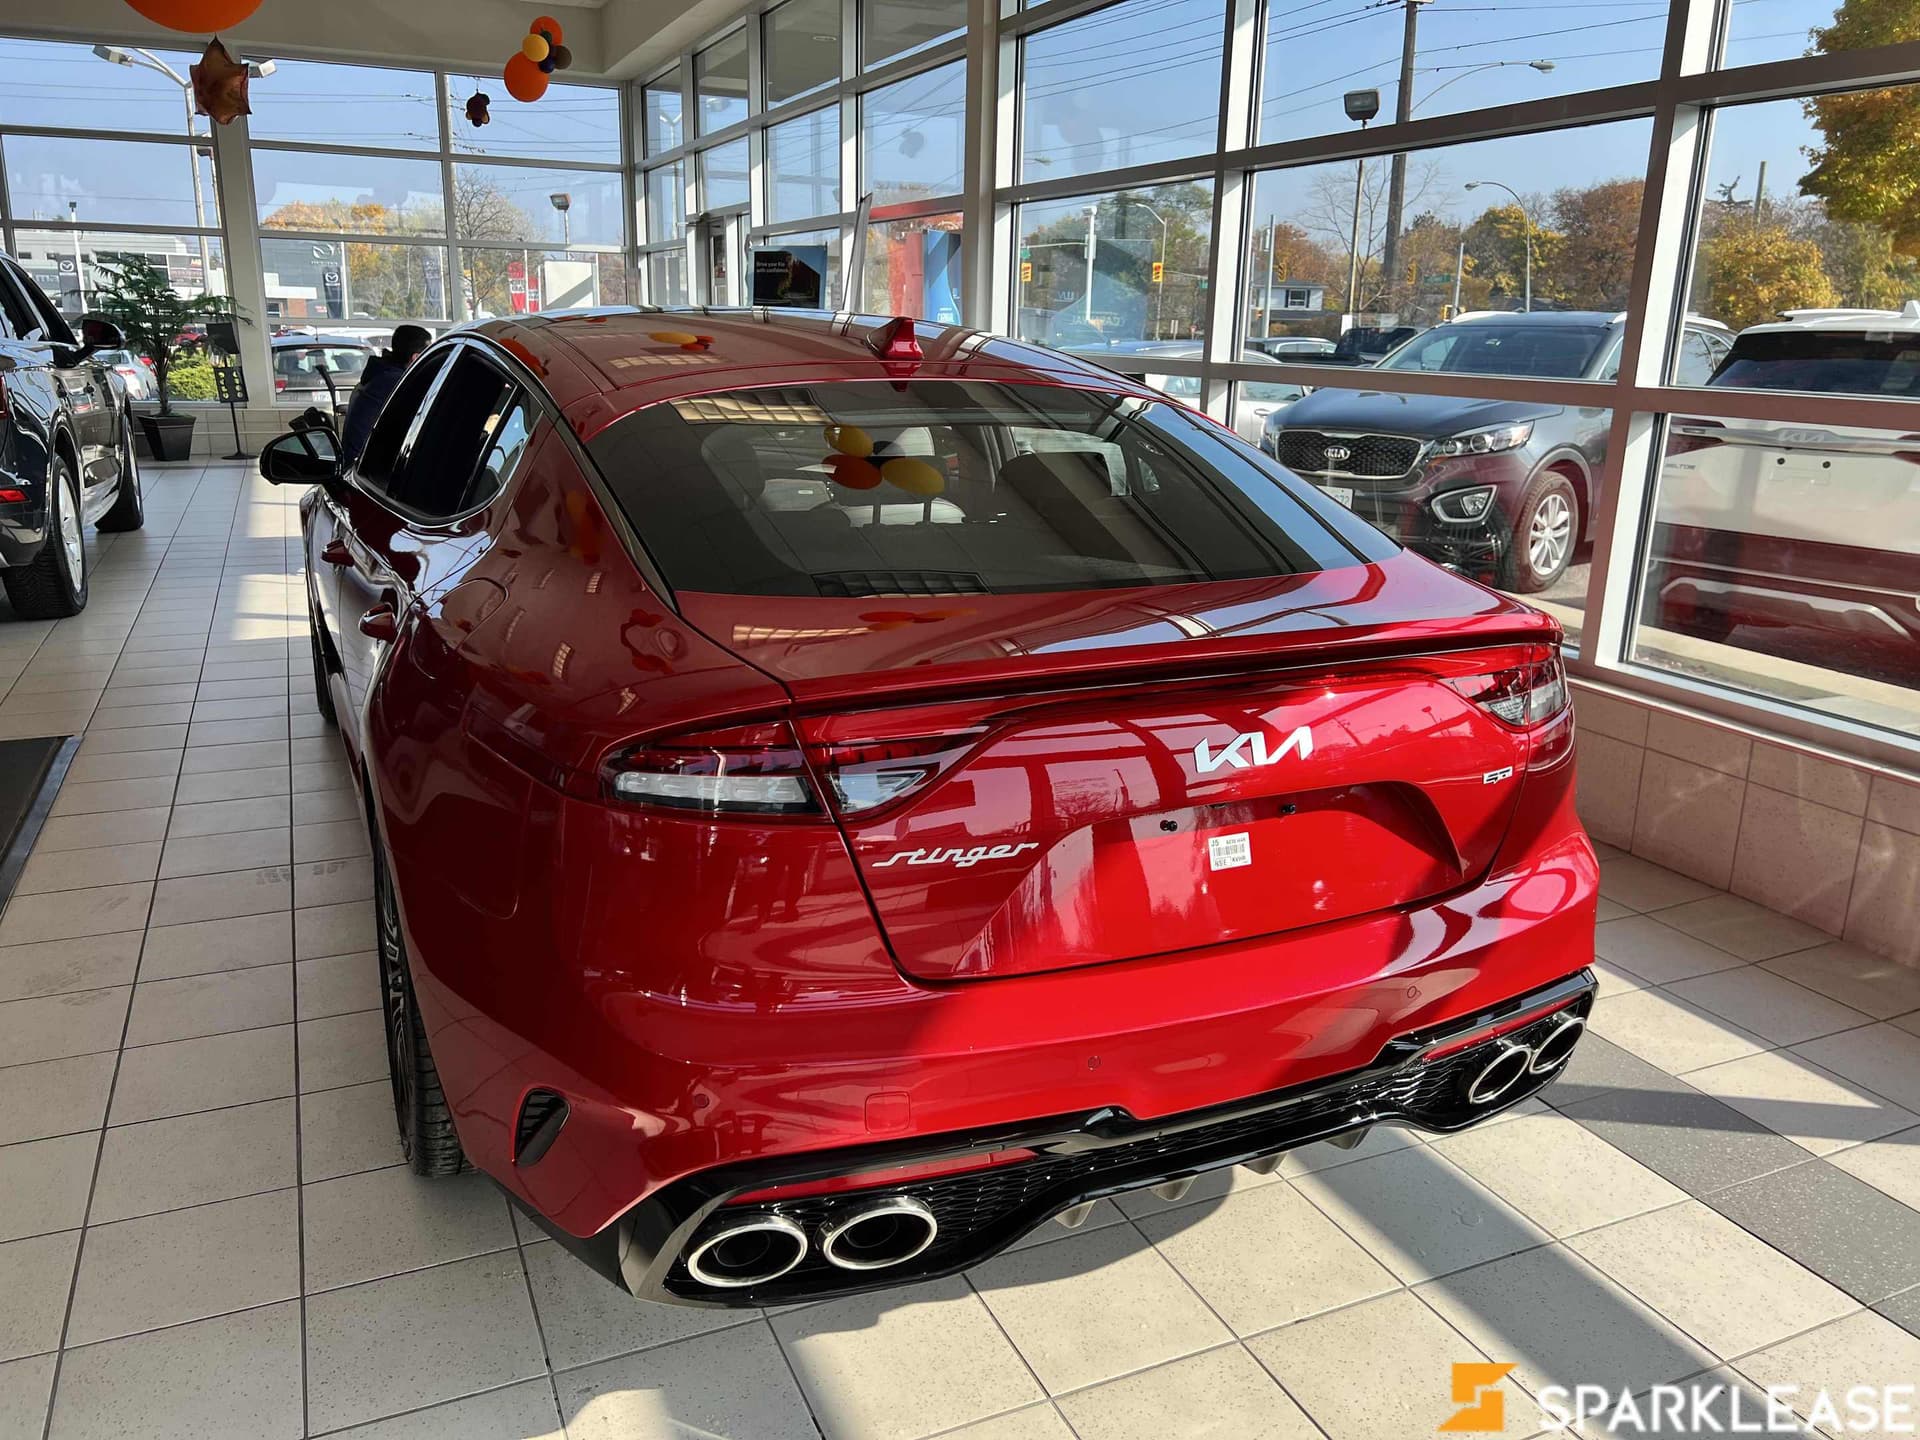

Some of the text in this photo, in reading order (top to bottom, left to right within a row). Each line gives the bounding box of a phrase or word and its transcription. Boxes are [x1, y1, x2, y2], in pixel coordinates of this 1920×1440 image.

[1326, 447, 1347, 459] KIA
[1194, 725, 1314, 774] KIA
[871, 842, 1040, 868] stinger
